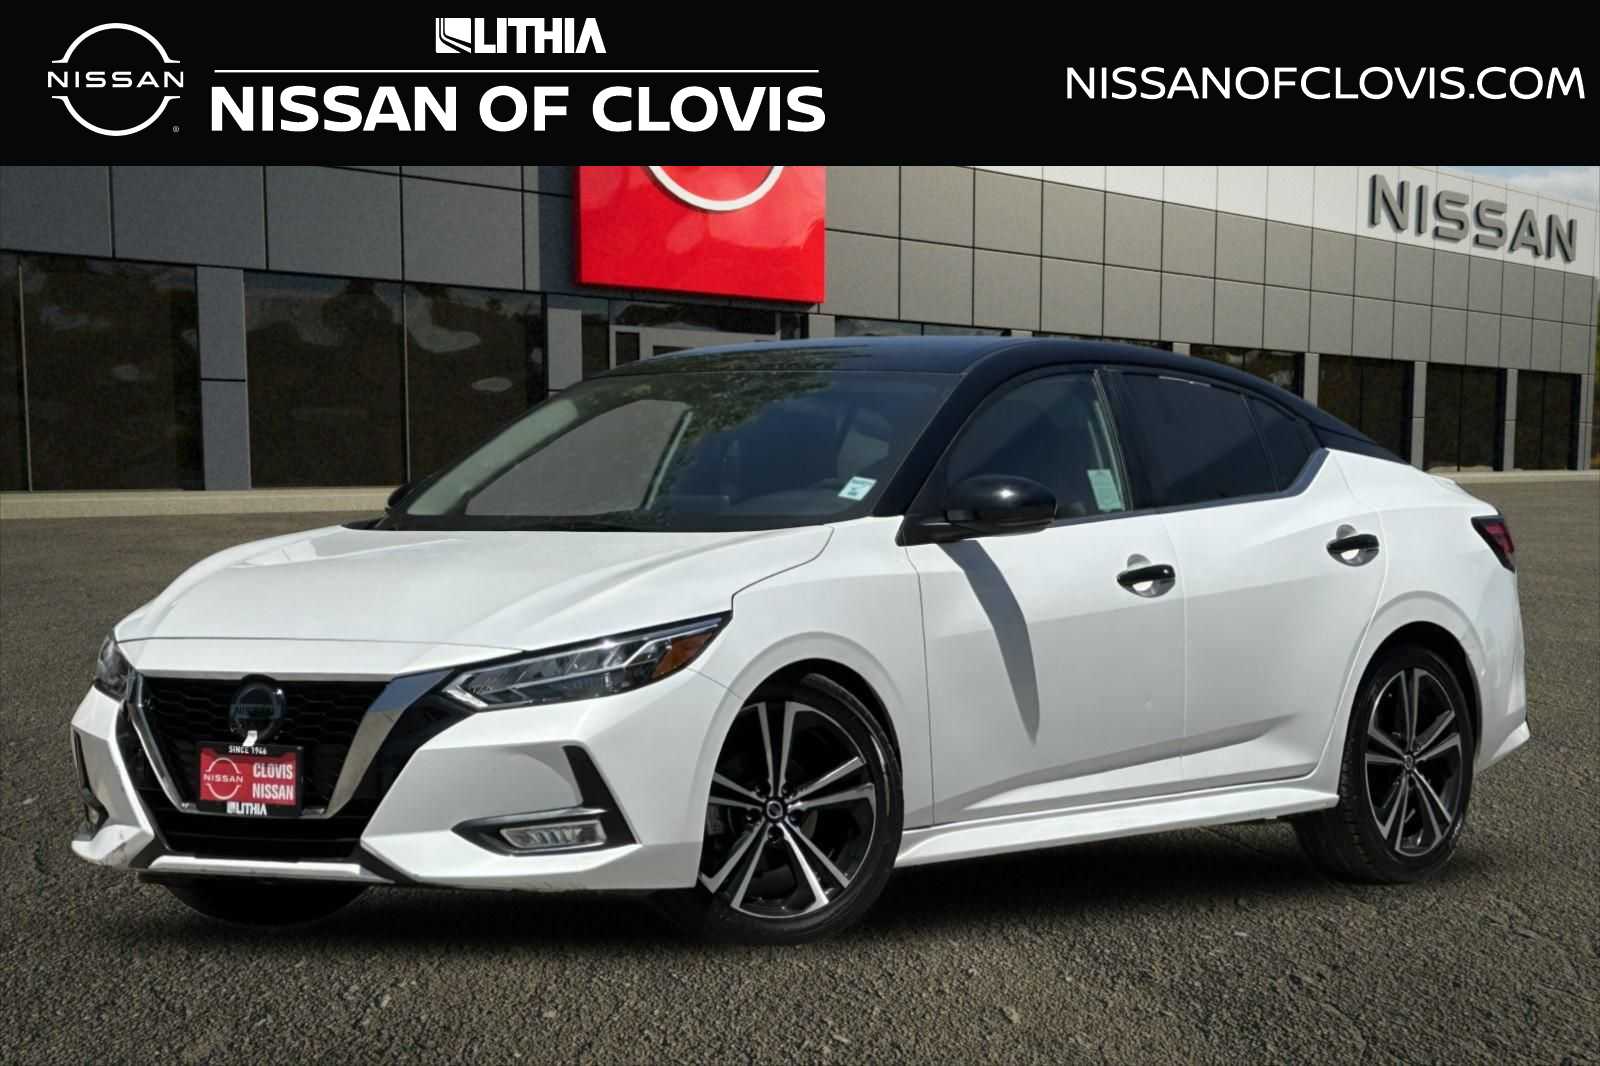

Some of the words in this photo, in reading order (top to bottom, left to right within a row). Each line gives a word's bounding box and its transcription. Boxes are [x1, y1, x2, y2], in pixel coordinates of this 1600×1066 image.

[1368, 174, 1577, 263] NISSAN
[228, 745, 249, 754] SINCE
[203, 774, 243, 783] NISSAN
[252, 763, 293, 780] CLOVIS
[252, 783, 294, 800] NISSAN
[236, 801, 267, 816] LITHIA
